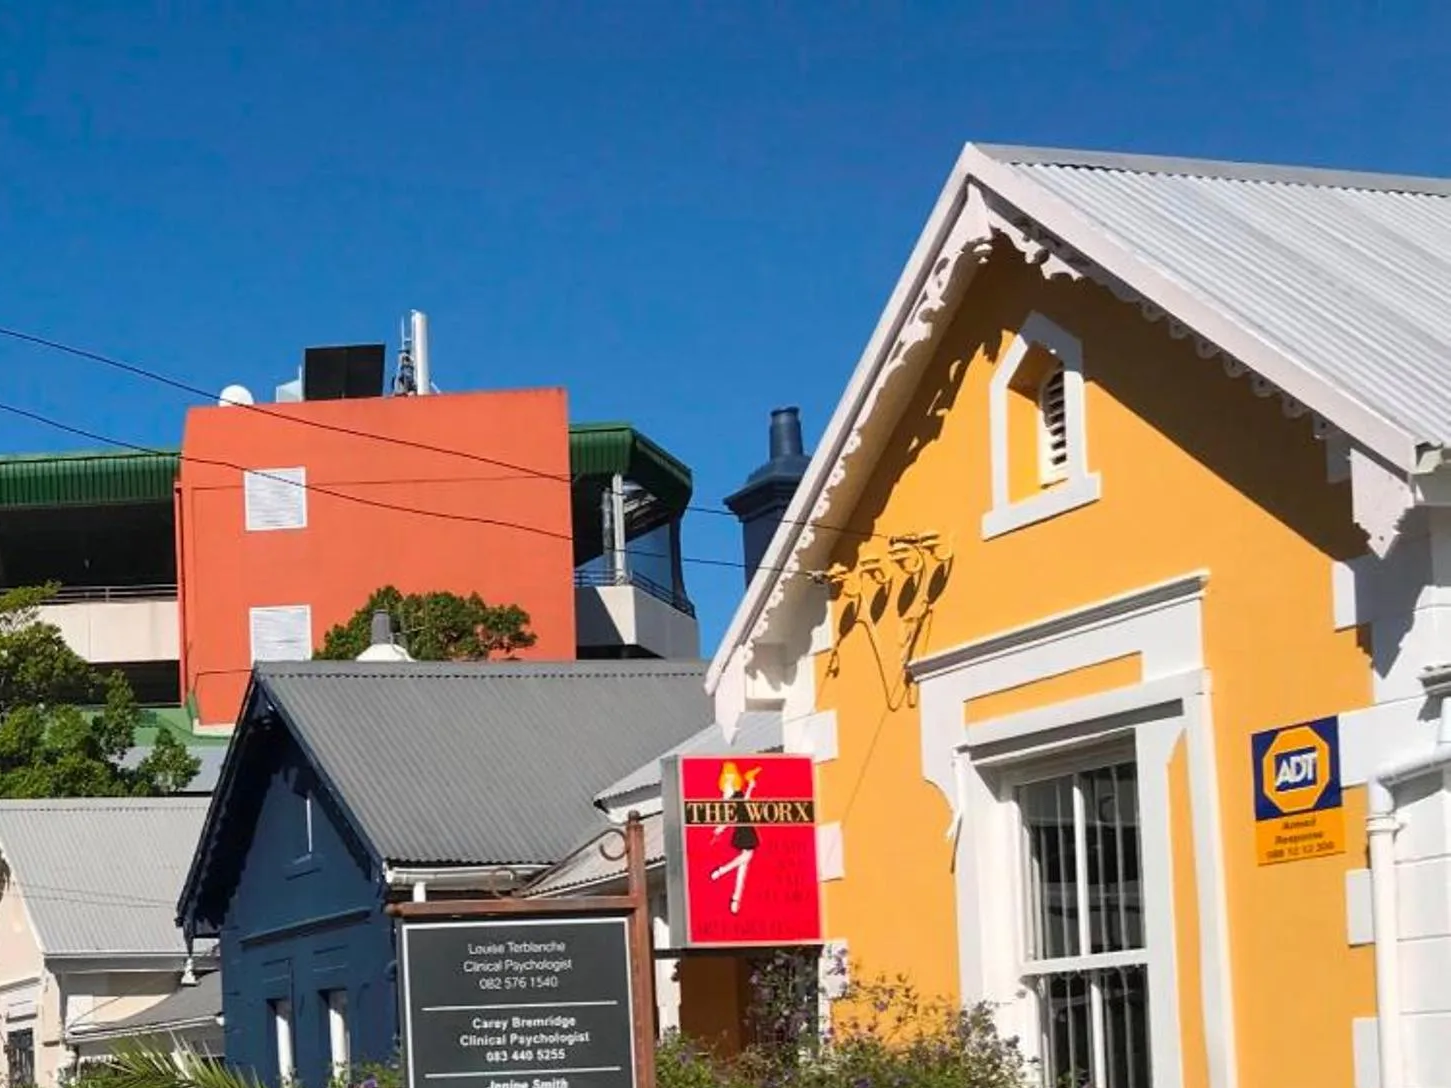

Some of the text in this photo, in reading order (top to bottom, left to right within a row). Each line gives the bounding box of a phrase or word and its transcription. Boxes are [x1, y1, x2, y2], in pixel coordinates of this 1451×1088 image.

[1274, 751, 1318, 787] ADT
[686, 802, 810, 823] THE WORX
[463, 957, 572, 973] Clinical Psychologist
[479, 975, 558, 990] 082 576 1540
[472, 1015, 576, 1030] Carey Bremridge
[459, 1031, 590, 1047] Clinical Psychologist
[511, 1049, 533, 1061] 440
